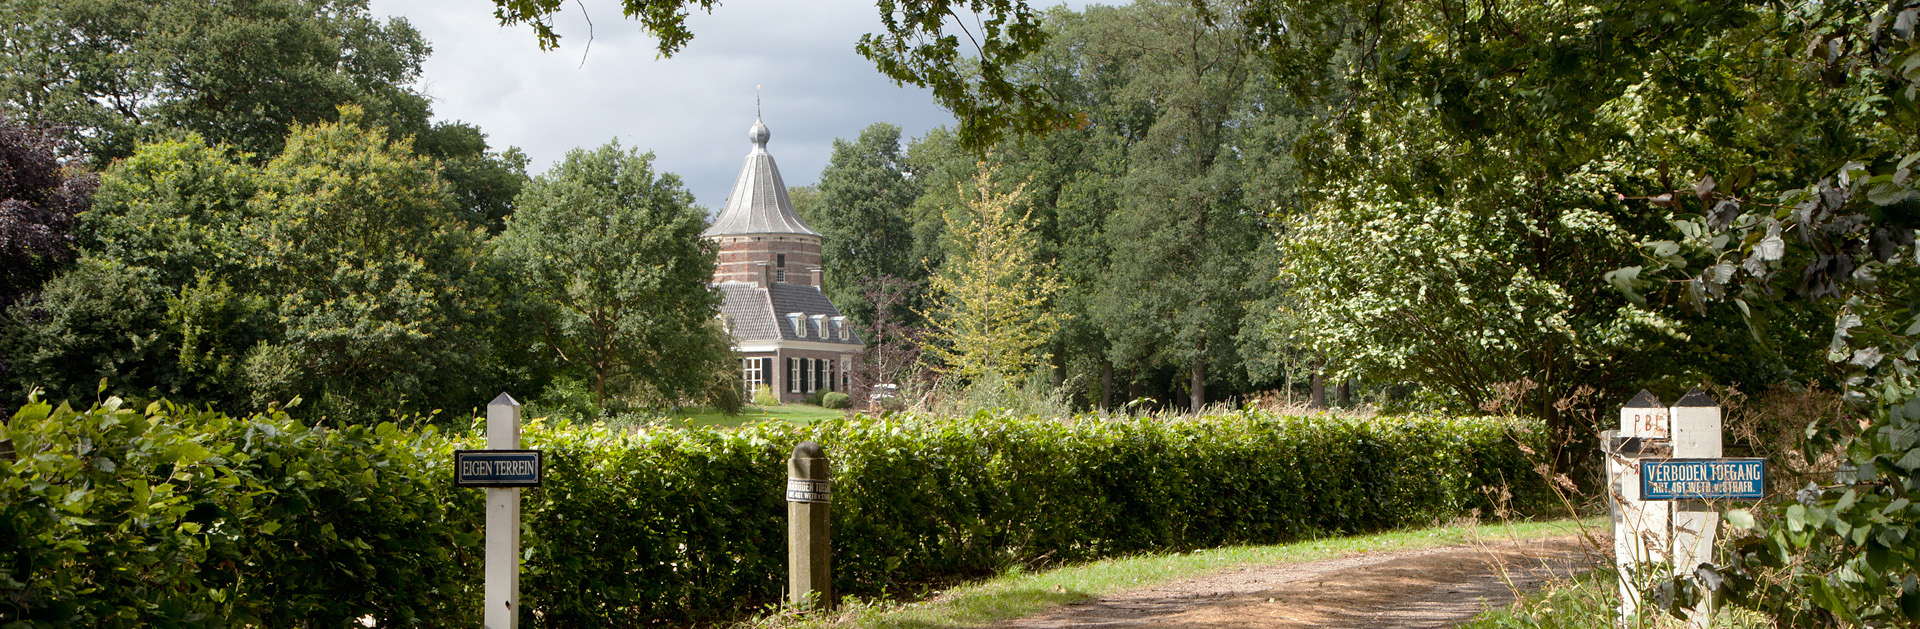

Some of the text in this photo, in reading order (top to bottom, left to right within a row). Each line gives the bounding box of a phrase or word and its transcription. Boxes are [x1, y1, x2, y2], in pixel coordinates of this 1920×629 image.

[463, 460, 534, 476] EIGEN TERREIN
[1647, 464, 1707, 482] VERBODEN
[1710, 464, 1761, 481] TOEGANG
